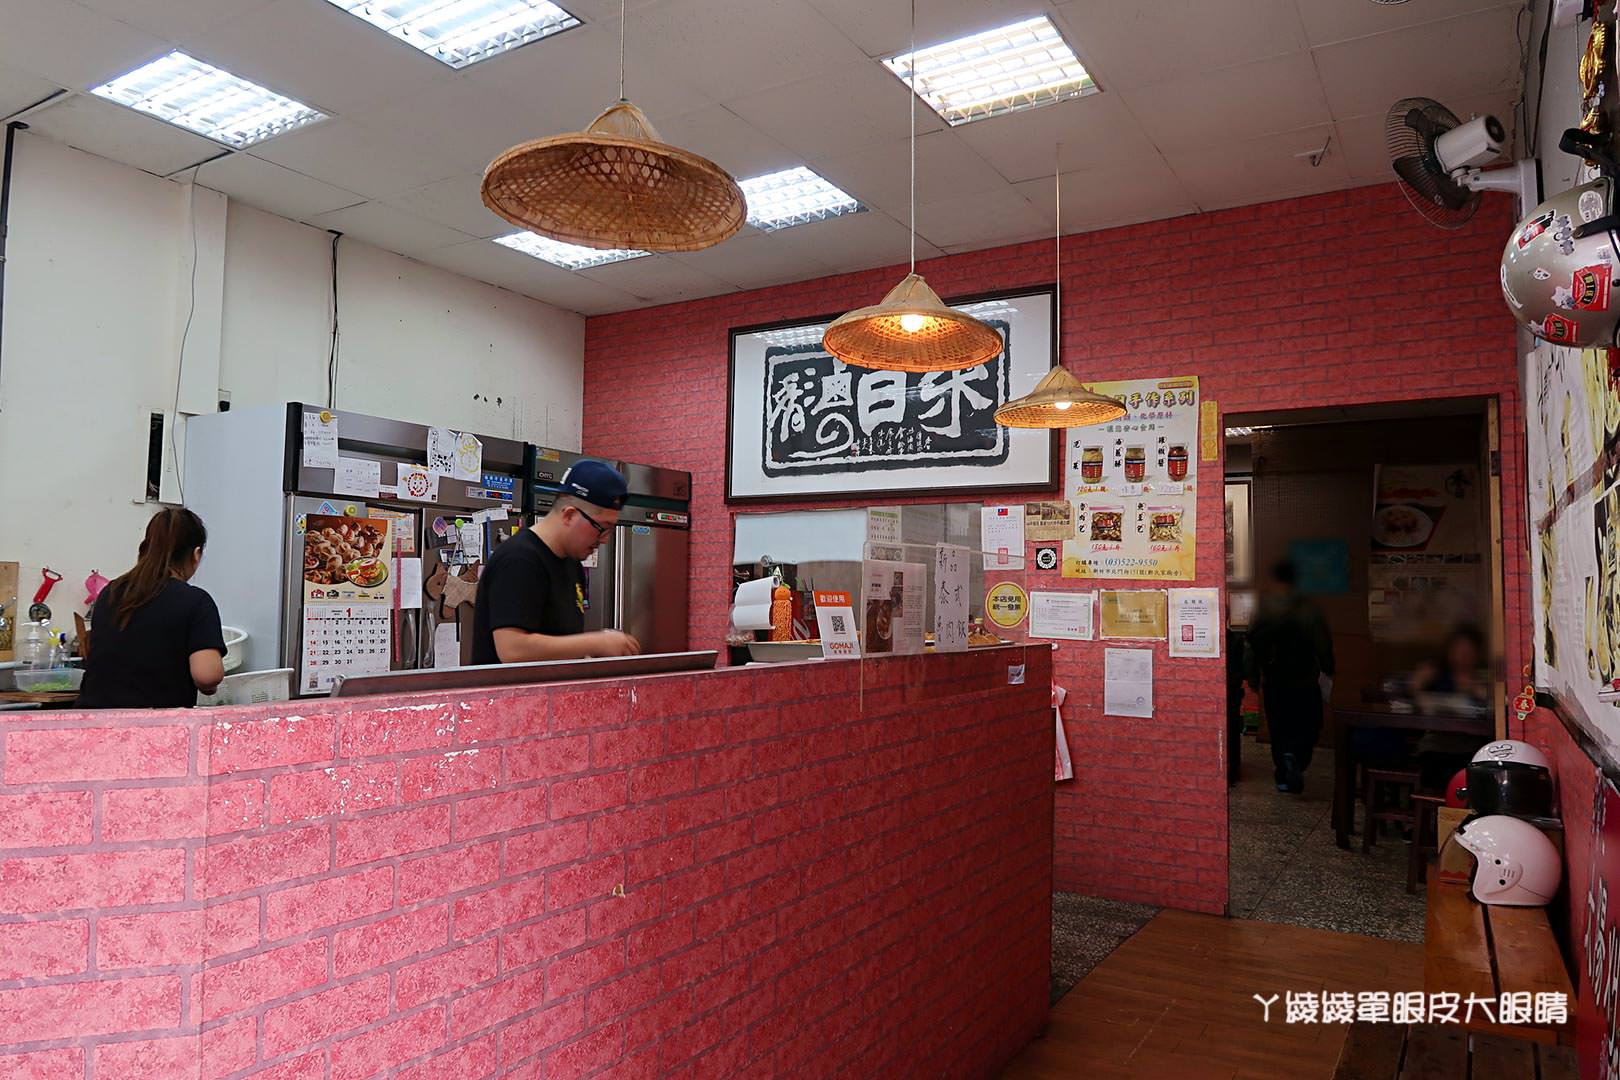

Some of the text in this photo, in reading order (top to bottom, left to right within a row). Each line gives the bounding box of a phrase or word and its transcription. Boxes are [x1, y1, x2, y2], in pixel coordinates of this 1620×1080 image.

[1104, 558, 1158, 567] (03)522-9550
[992, 595, 1022, 603] 本店免用
[992, 603, 1022, 611] 統一發票
[346, 608, 353, 618] 1
[829, 642, 853, 650] GOMAJI
